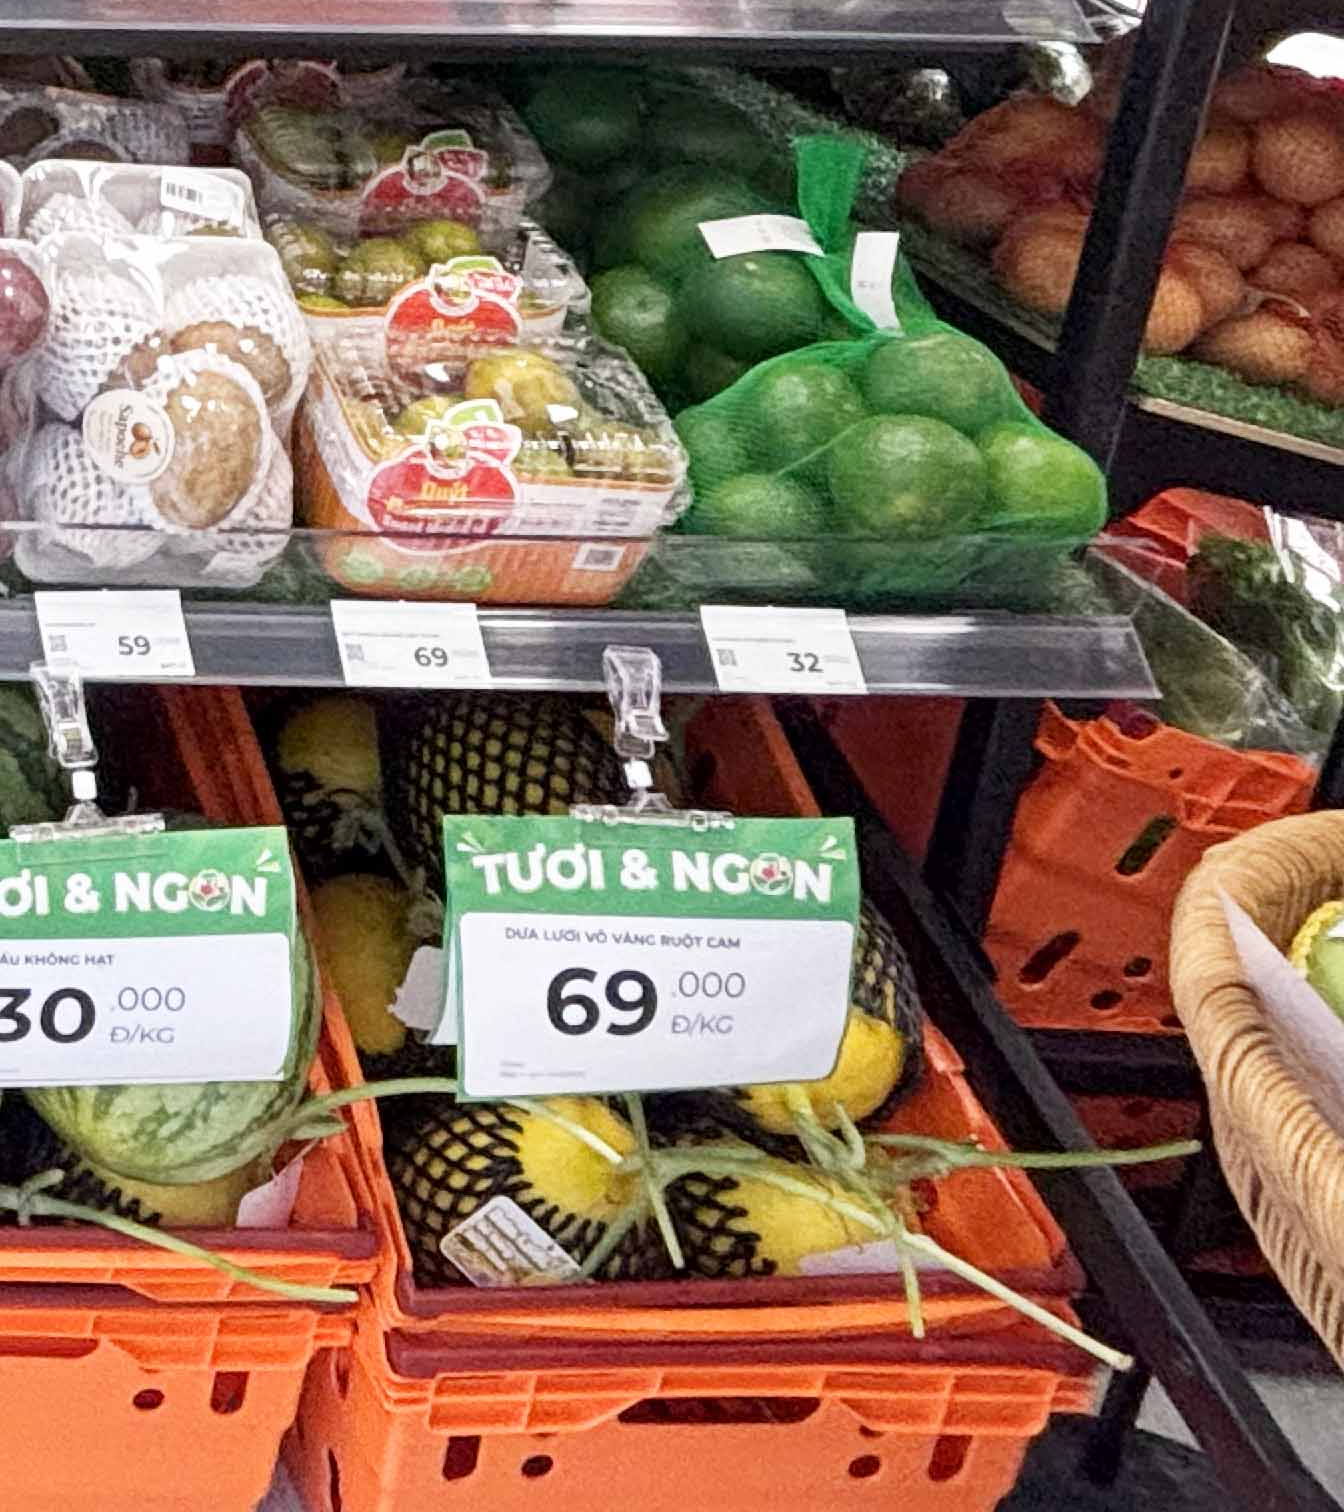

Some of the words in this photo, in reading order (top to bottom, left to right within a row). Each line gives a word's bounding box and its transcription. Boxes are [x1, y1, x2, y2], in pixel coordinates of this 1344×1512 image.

[114, 404, 133, 470] Sapoche
[117, 635, 151, 656] 59
[413, 646, 449, 668] 69
[787, 652, 823, 673] 32
[470, 842, 604, 896] TƯƠI
[619, 848, 659, 890] &
[671, 849, 833, 904] NGON
[63, 872, 101, 914] &
[113, 868, 269, 917] NGON
[707, 936, 741, 950] CAM
[546, 966, 659, 1037] 69
